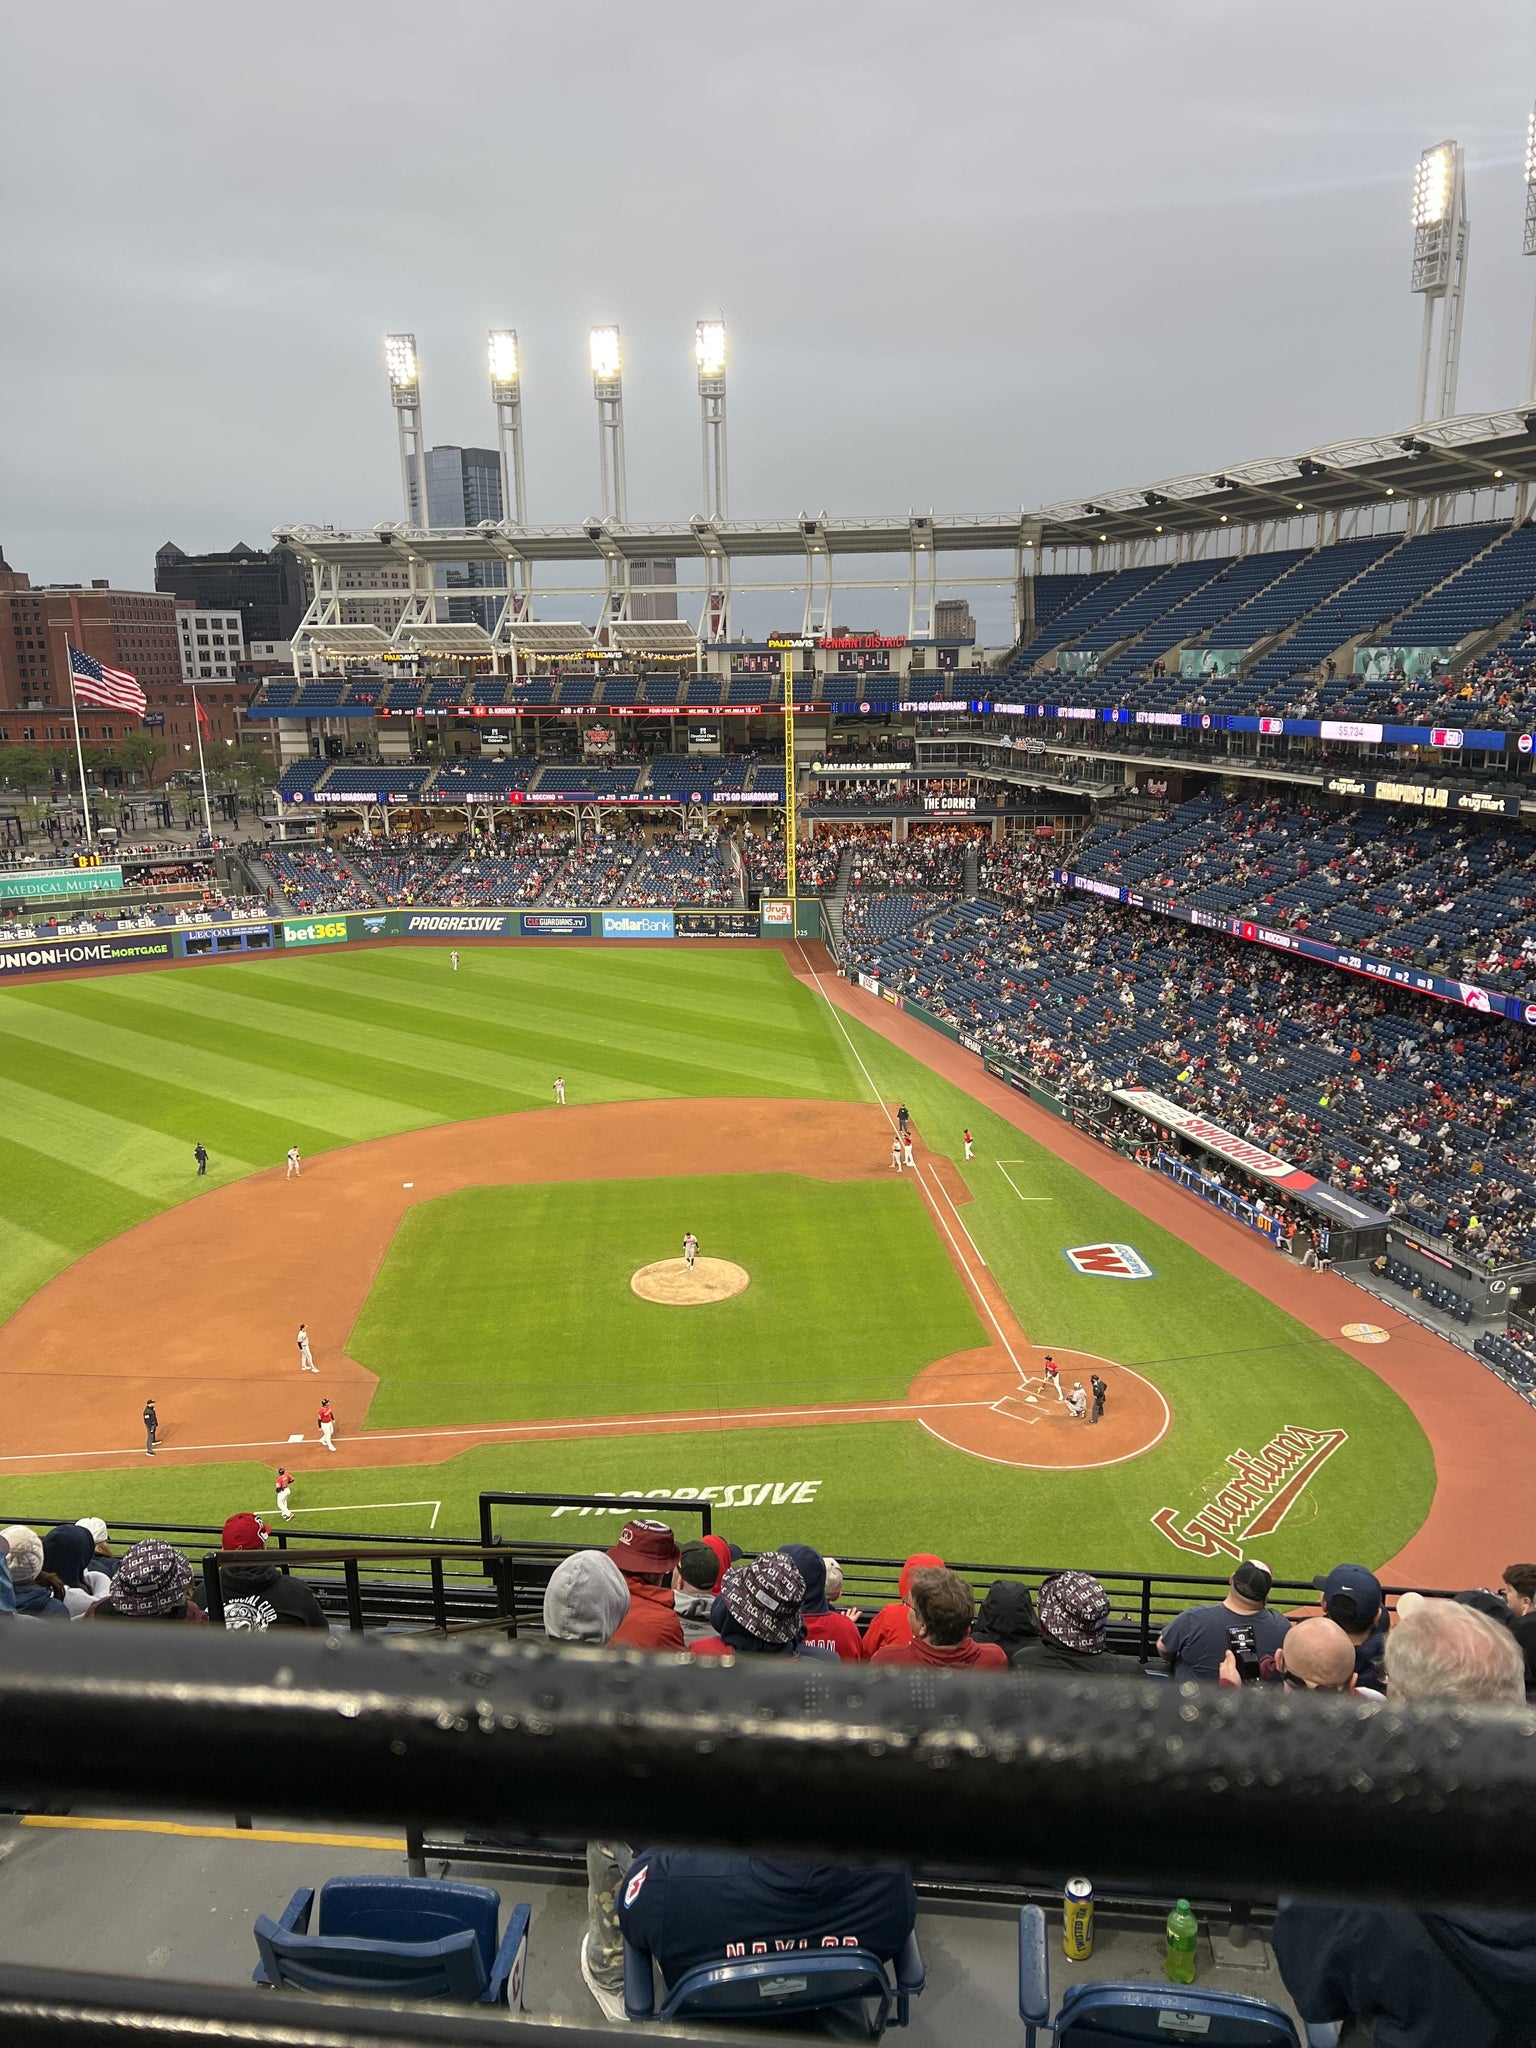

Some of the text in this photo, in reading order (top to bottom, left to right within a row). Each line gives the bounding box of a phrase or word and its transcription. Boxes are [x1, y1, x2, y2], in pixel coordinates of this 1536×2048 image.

[819, 635, 908, 649] PENNANT DISTRICT
[899, 701, 967, 713] LET'S GO GUARDIANS!
[1338, 726, 1364, 737] $5,734
[823, 762, 912, 771] FAT HEAD'S BREWERY
[1328, 779, 1347, 795] drug
[1347, 783, 1366, 794] mart
[313, 792, 331, 802] LET'S
[331, 793, 340, 802] GO
[713, 793, 779, 802] LET'S GO GUARDIANS!
[1375, 781, 1449, 808] CHAMPIONS CLUB
[924, 797, 977, 810] THE CORNER
[1458, 794, 1481, 812] drug
[1481, 798, 1506, 812] mart
[64, 867, 91, 875] Cleveland
[765, 904, 789, 915] drug
[767, 912, 793, 921] mart
[408, 916, 504, 931] PROGRESSIVE
[284, 922, 347, 942] bet365
[1175, 1119, 1284, 1171] GUARDIANS
[551, 1480, 823, 1518] RESSIVE
[1150, 1425, 1345, 1562] Guardians
[259, 1600, 278, 1622] CLUB
[1074, 1907, 1088, 1952] TWISTED TEA
